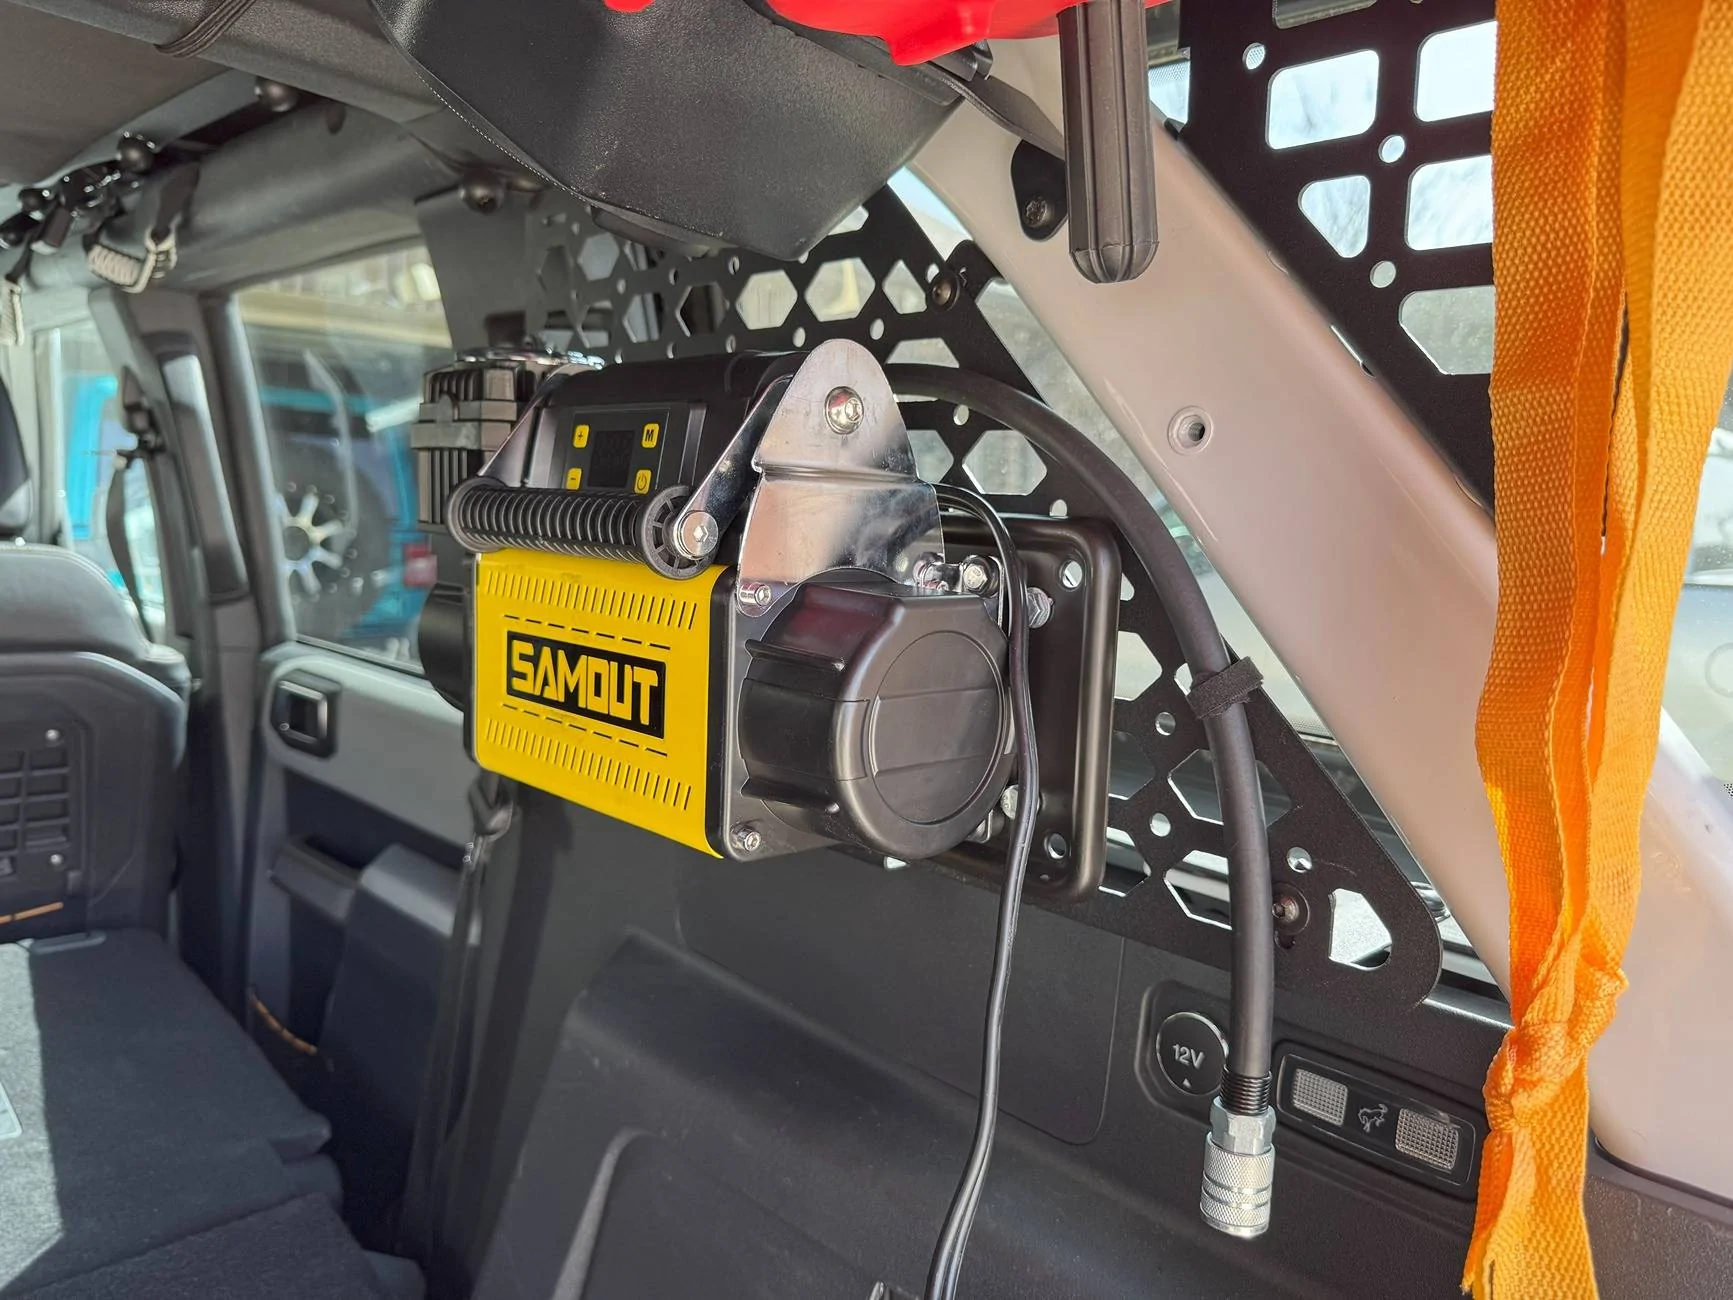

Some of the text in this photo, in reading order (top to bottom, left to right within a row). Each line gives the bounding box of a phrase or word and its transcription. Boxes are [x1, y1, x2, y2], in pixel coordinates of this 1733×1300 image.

[645, 429, 654, 442] M
[511, 639, 658, 726] SAMOUT
[1172, 1044, 1205, 1070] 12V
